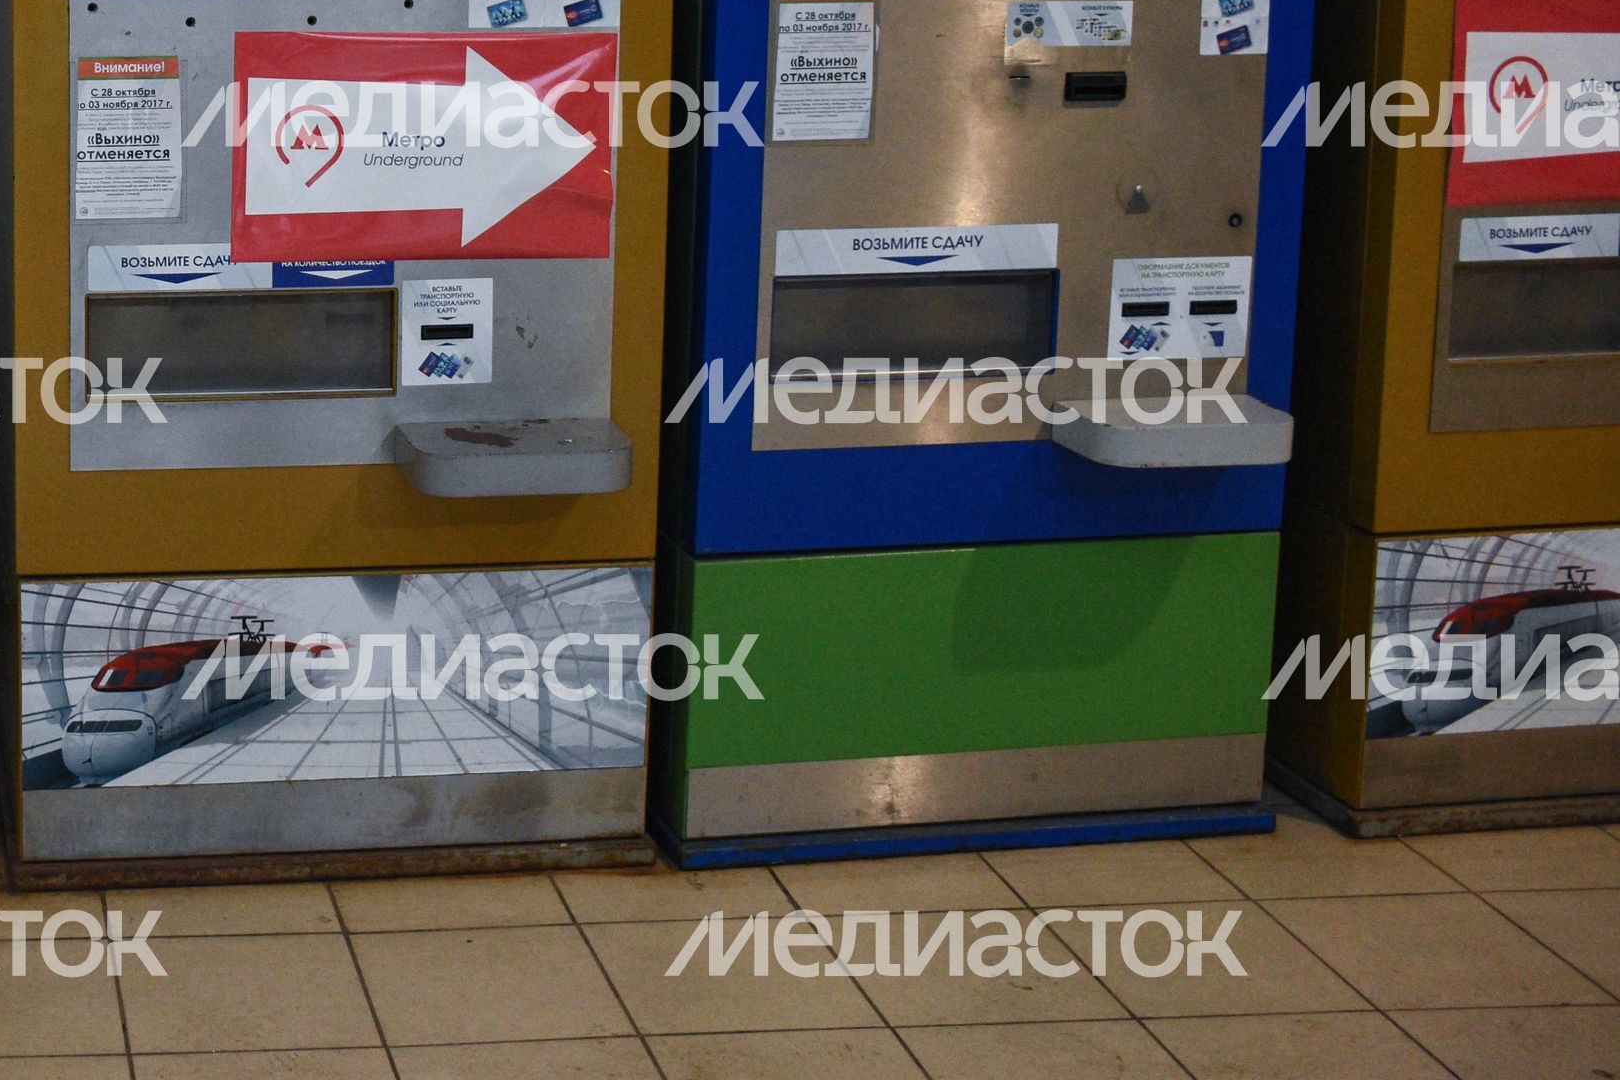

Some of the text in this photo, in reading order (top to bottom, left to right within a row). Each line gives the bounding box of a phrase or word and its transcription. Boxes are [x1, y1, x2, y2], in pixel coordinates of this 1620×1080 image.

[94, 61, 165, 74] Внимание!
[780, 71, 867, 83] отменяется
[101, 87, 156, 98] 28 октября
[88, 99, 163, 110] 03 ноября 2017
[381, 131, 446, 153] Метро
[76, 148, 170, 160] отменяется
[363, 152, 464, 170] Underground
[1489, 225, 1593, 240] ВОЗЬМИТЕ СДАЧУ
[852, 235, 984, 251] ВОЗЬМИТЕ СДАЧУ
[121, 255, 237, 269] ВОЗЬМИТЕ СДАЧ
[431, 285, 463, 293] ВСТАВЬТЕ
[419, 291, 475, 300] ТРАНСПОРТНУЮ
[429, 299, 481, 309] СОЦИАЛЬНУЮ
[436, 306, 458, 315] КАРТУ
